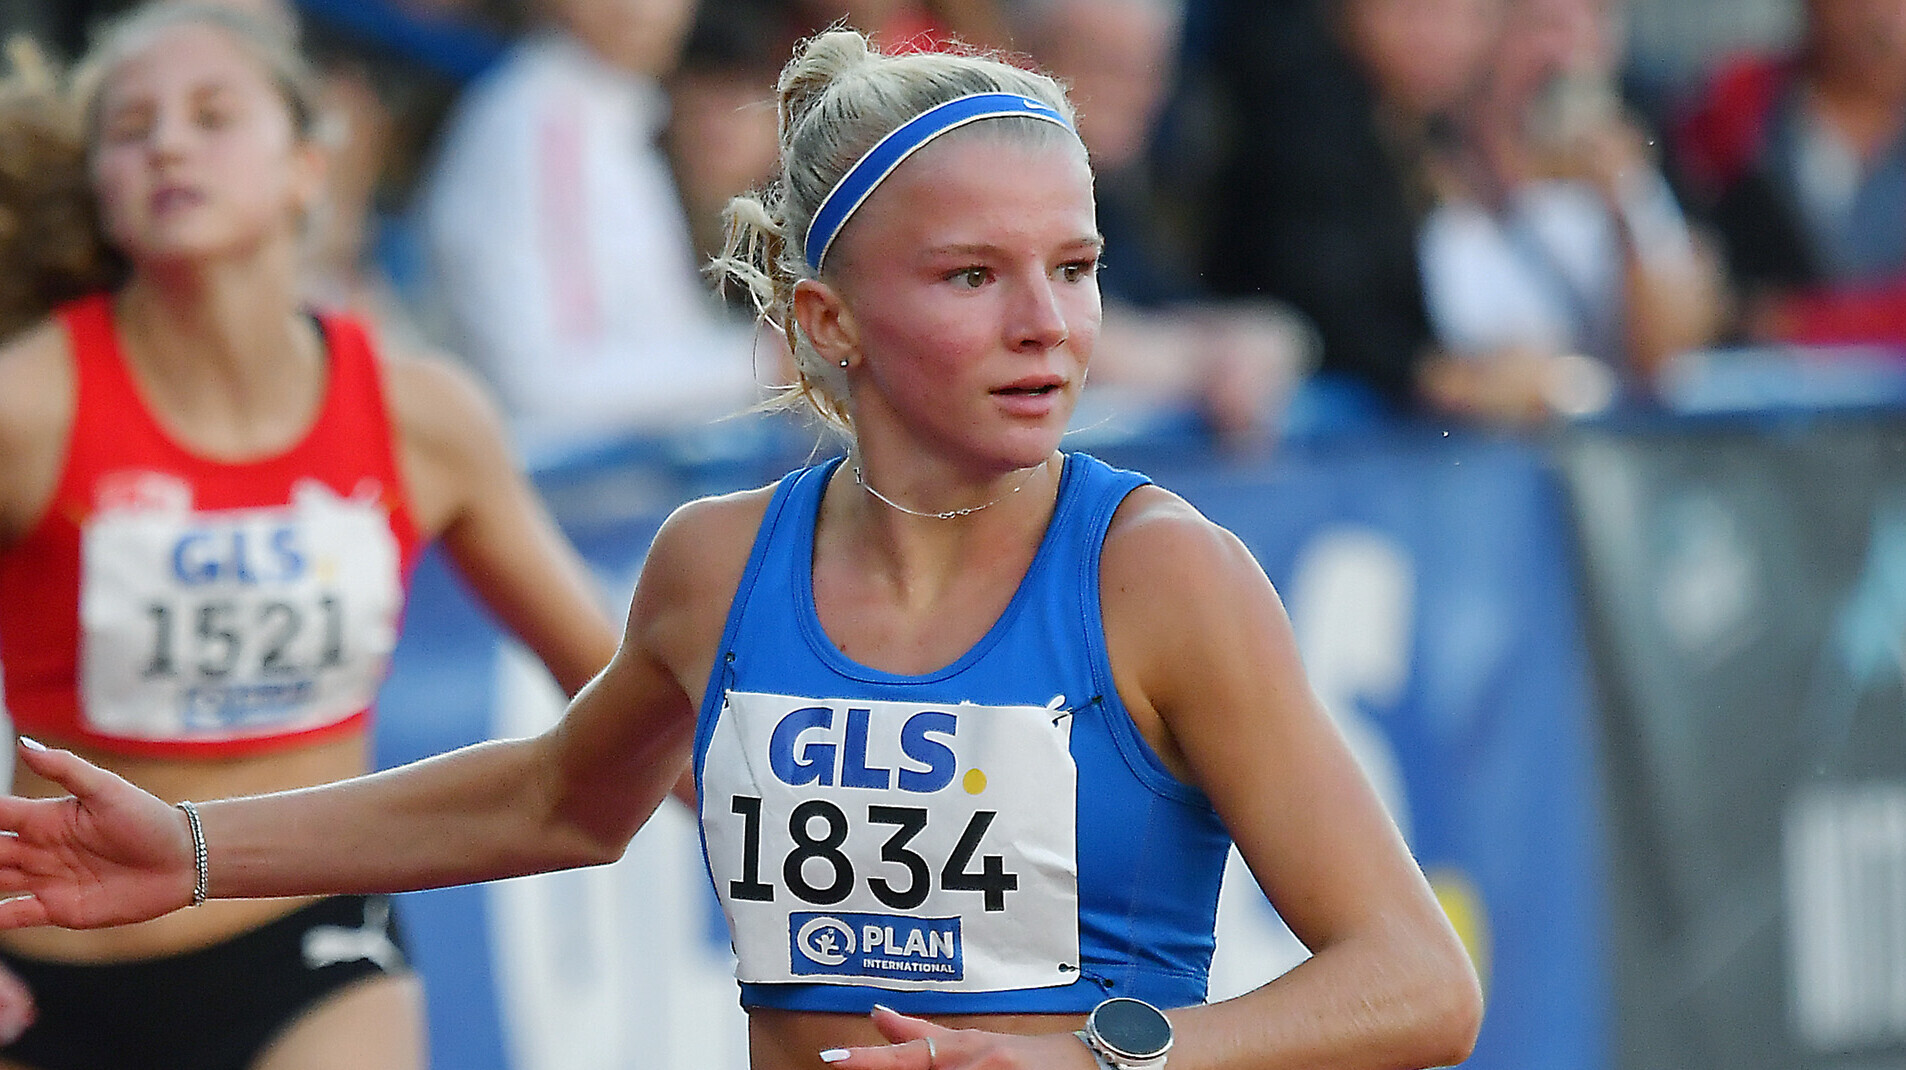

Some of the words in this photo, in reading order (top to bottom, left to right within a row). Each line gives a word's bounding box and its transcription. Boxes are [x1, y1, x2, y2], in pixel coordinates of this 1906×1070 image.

[141, 594, 347, 680] 1521
[729, 795, 1018, 912] 1834
[862, 925, 954, 959] PLAN
[863, 958, 955, 974] INTERNATIONAL
